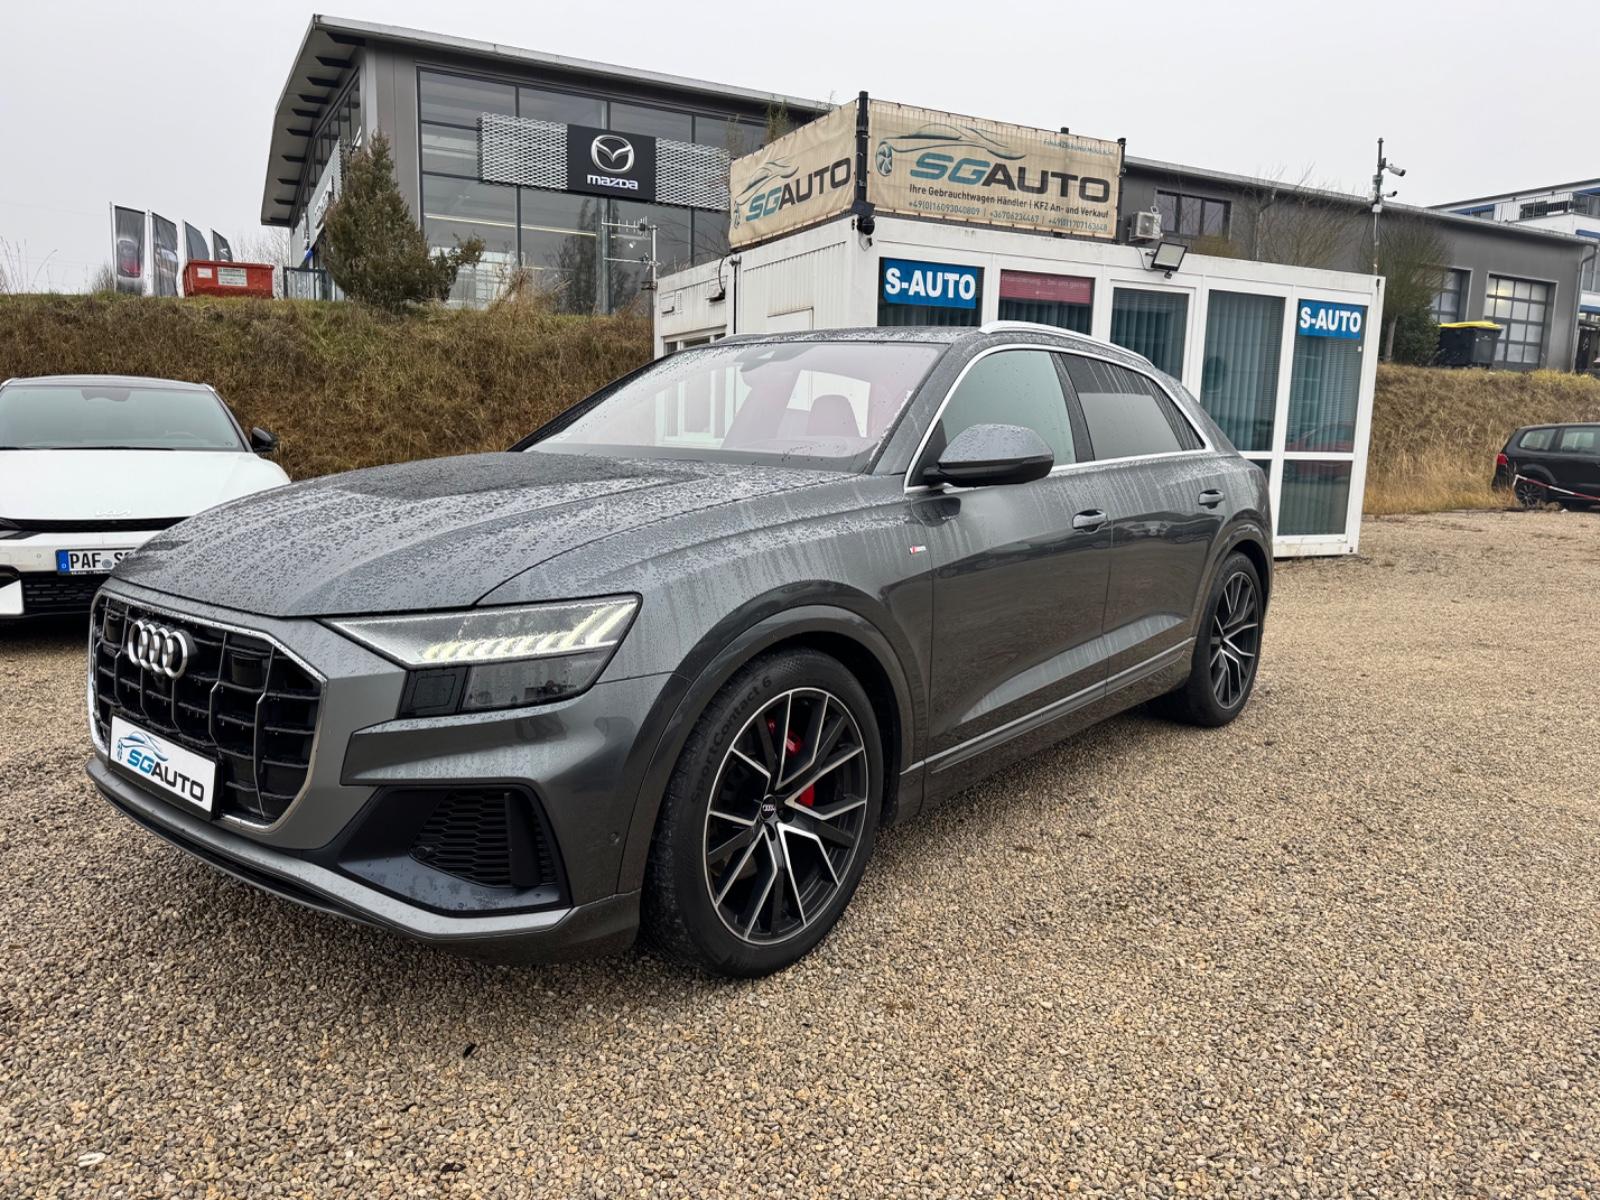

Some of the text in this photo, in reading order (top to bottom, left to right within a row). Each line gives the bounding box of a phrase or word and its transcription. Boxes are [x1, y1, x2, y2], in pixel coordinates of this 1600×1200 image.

[745, 157, 851, 222] SGAUTO
[910, 152, 1110, 204] SGAUTO
[909, 184, 926, 195] Ihre
[928, 186, 995, 204] Gebrauchtwagen
[996, 195, 1027, 208] Händler
[1033, 201, 1049, 211] KFZ
[1050, 203, 1064, 212] An-
[1080, 207, 1109, 219] Verkauf
[885, 267, 976, 300] S-AUTO
[1299, 306, 1361, 333] S-AUTO
[69, 552, 101, 569] PAF
[127, 748, 205, 802] SGAUTO
